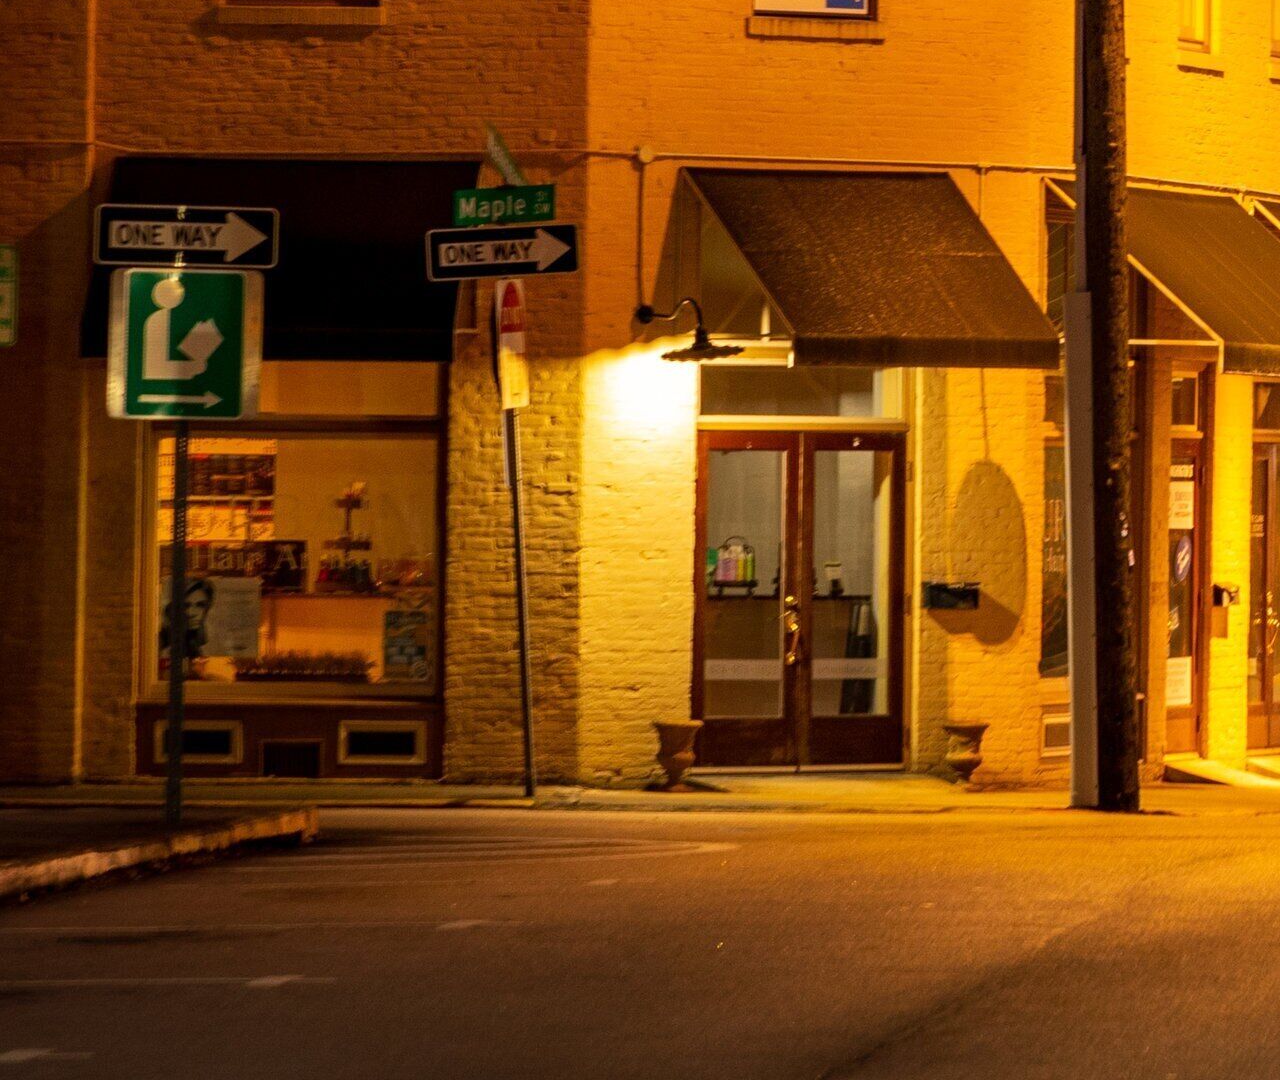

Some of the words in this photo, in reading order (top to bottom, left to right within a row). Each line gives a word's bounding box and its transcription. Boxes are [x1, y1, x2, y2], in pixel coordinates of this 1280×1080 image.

[458, 196, 527, 221] Maple
[116, 224, 164, 246] ONE
[172, 224, 223, 247] WAY
[445, 243, 485, 264] ONE
[493, 240, 533, 262] WAY
